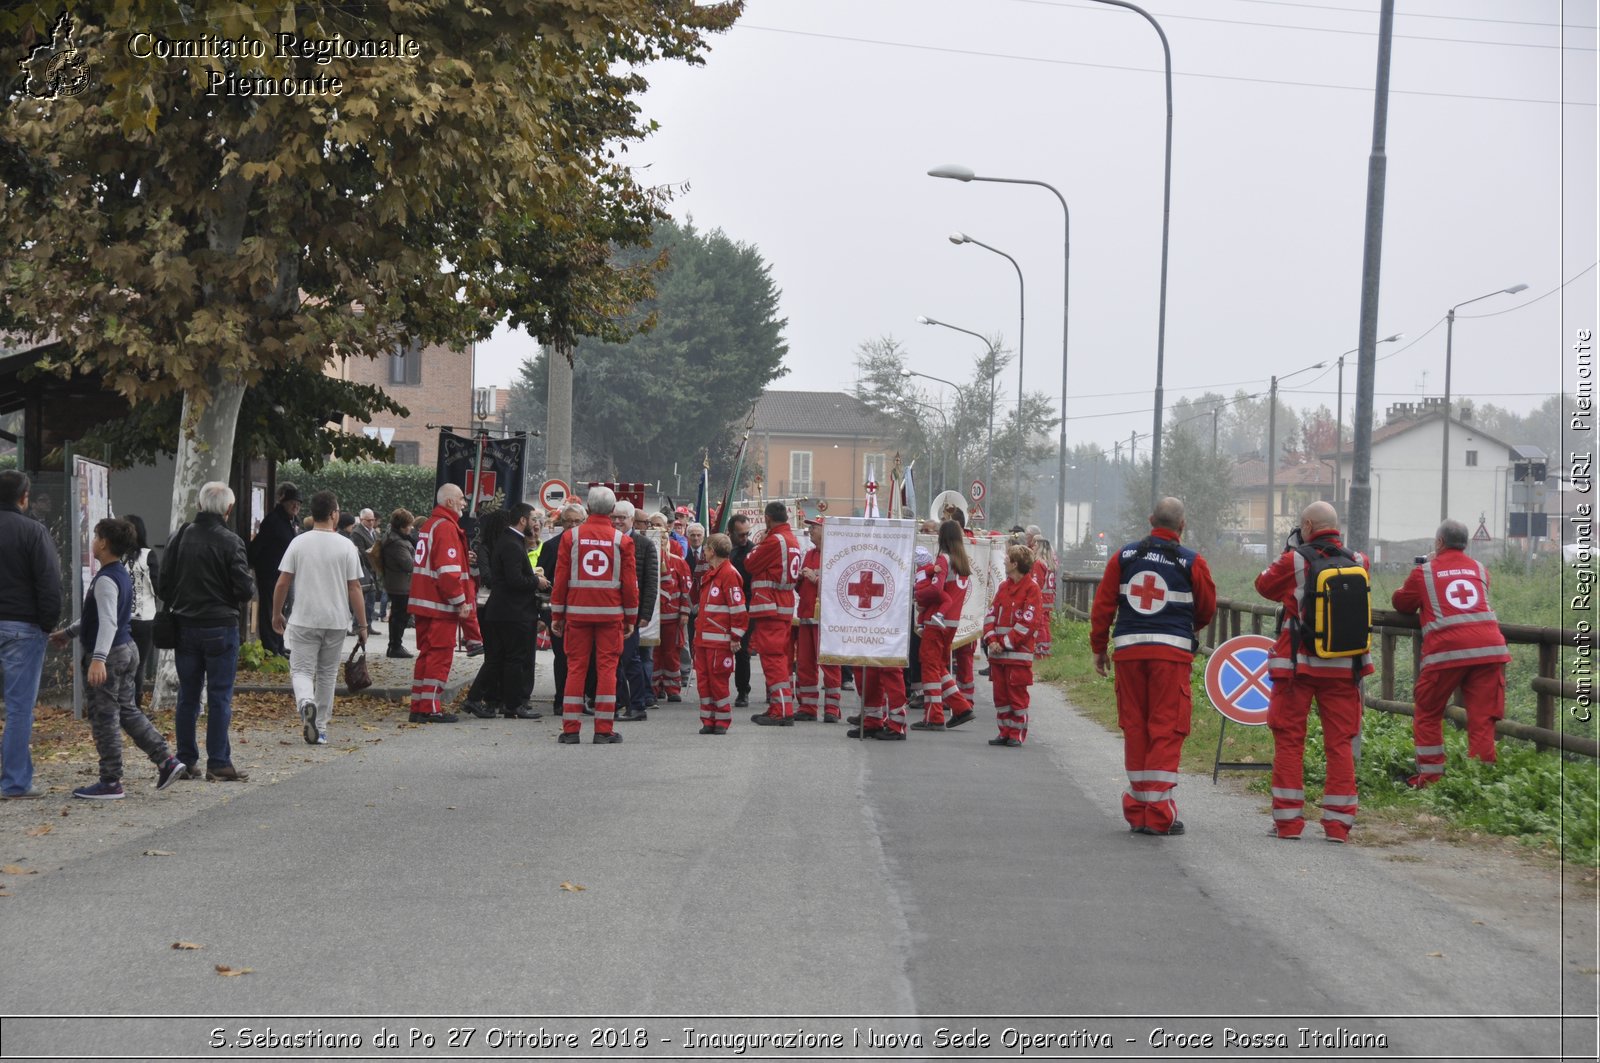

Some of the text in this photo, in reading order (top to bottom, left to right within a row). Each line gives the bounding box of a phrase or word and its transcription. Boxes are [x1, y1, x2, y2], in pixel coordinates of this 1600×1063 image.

[972, 485, 982, 497] 30
[826, 530, 844, 538] CORPO
[825, 547, 850, 570] CROCE
[850, 543, 879, 553] ROSSA
[827, 624, 900, 635] COMITATO LOCALE
[841, 635, 885, 645] LAURIANO
